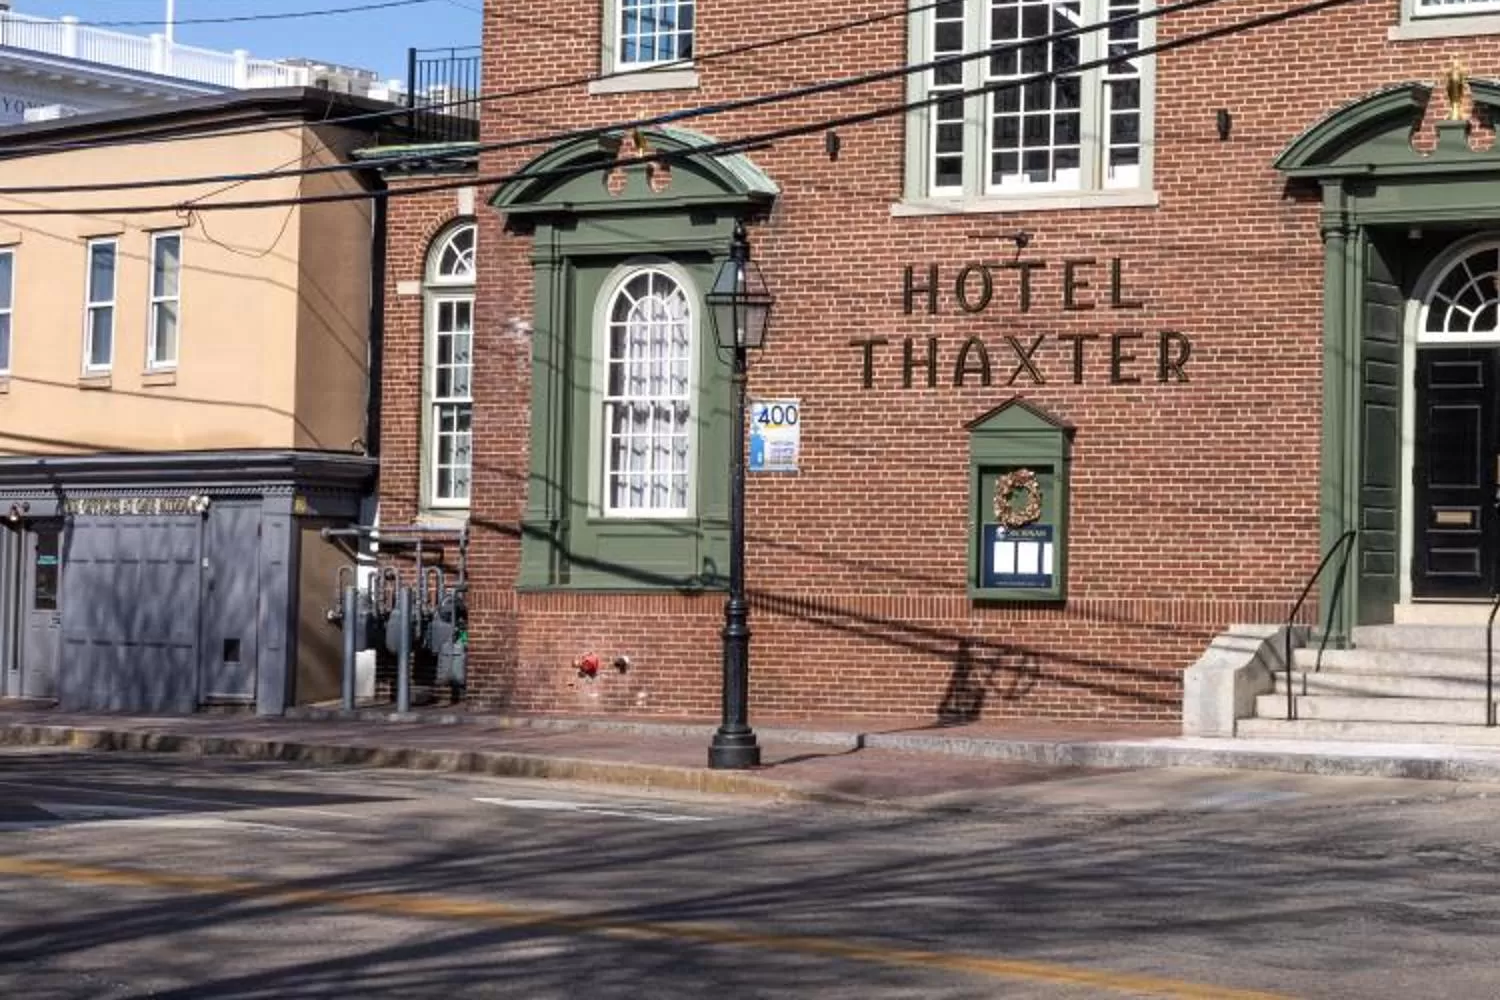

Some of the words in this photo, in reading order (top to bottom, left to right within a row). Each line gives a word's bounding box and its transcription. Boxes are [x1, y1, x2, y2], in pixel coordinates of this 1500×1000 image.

[904, 257, 1143, 315] HOTEL
[849, 331, 1192, 388] THAXTER
[758, 405, 798, 425] 400
